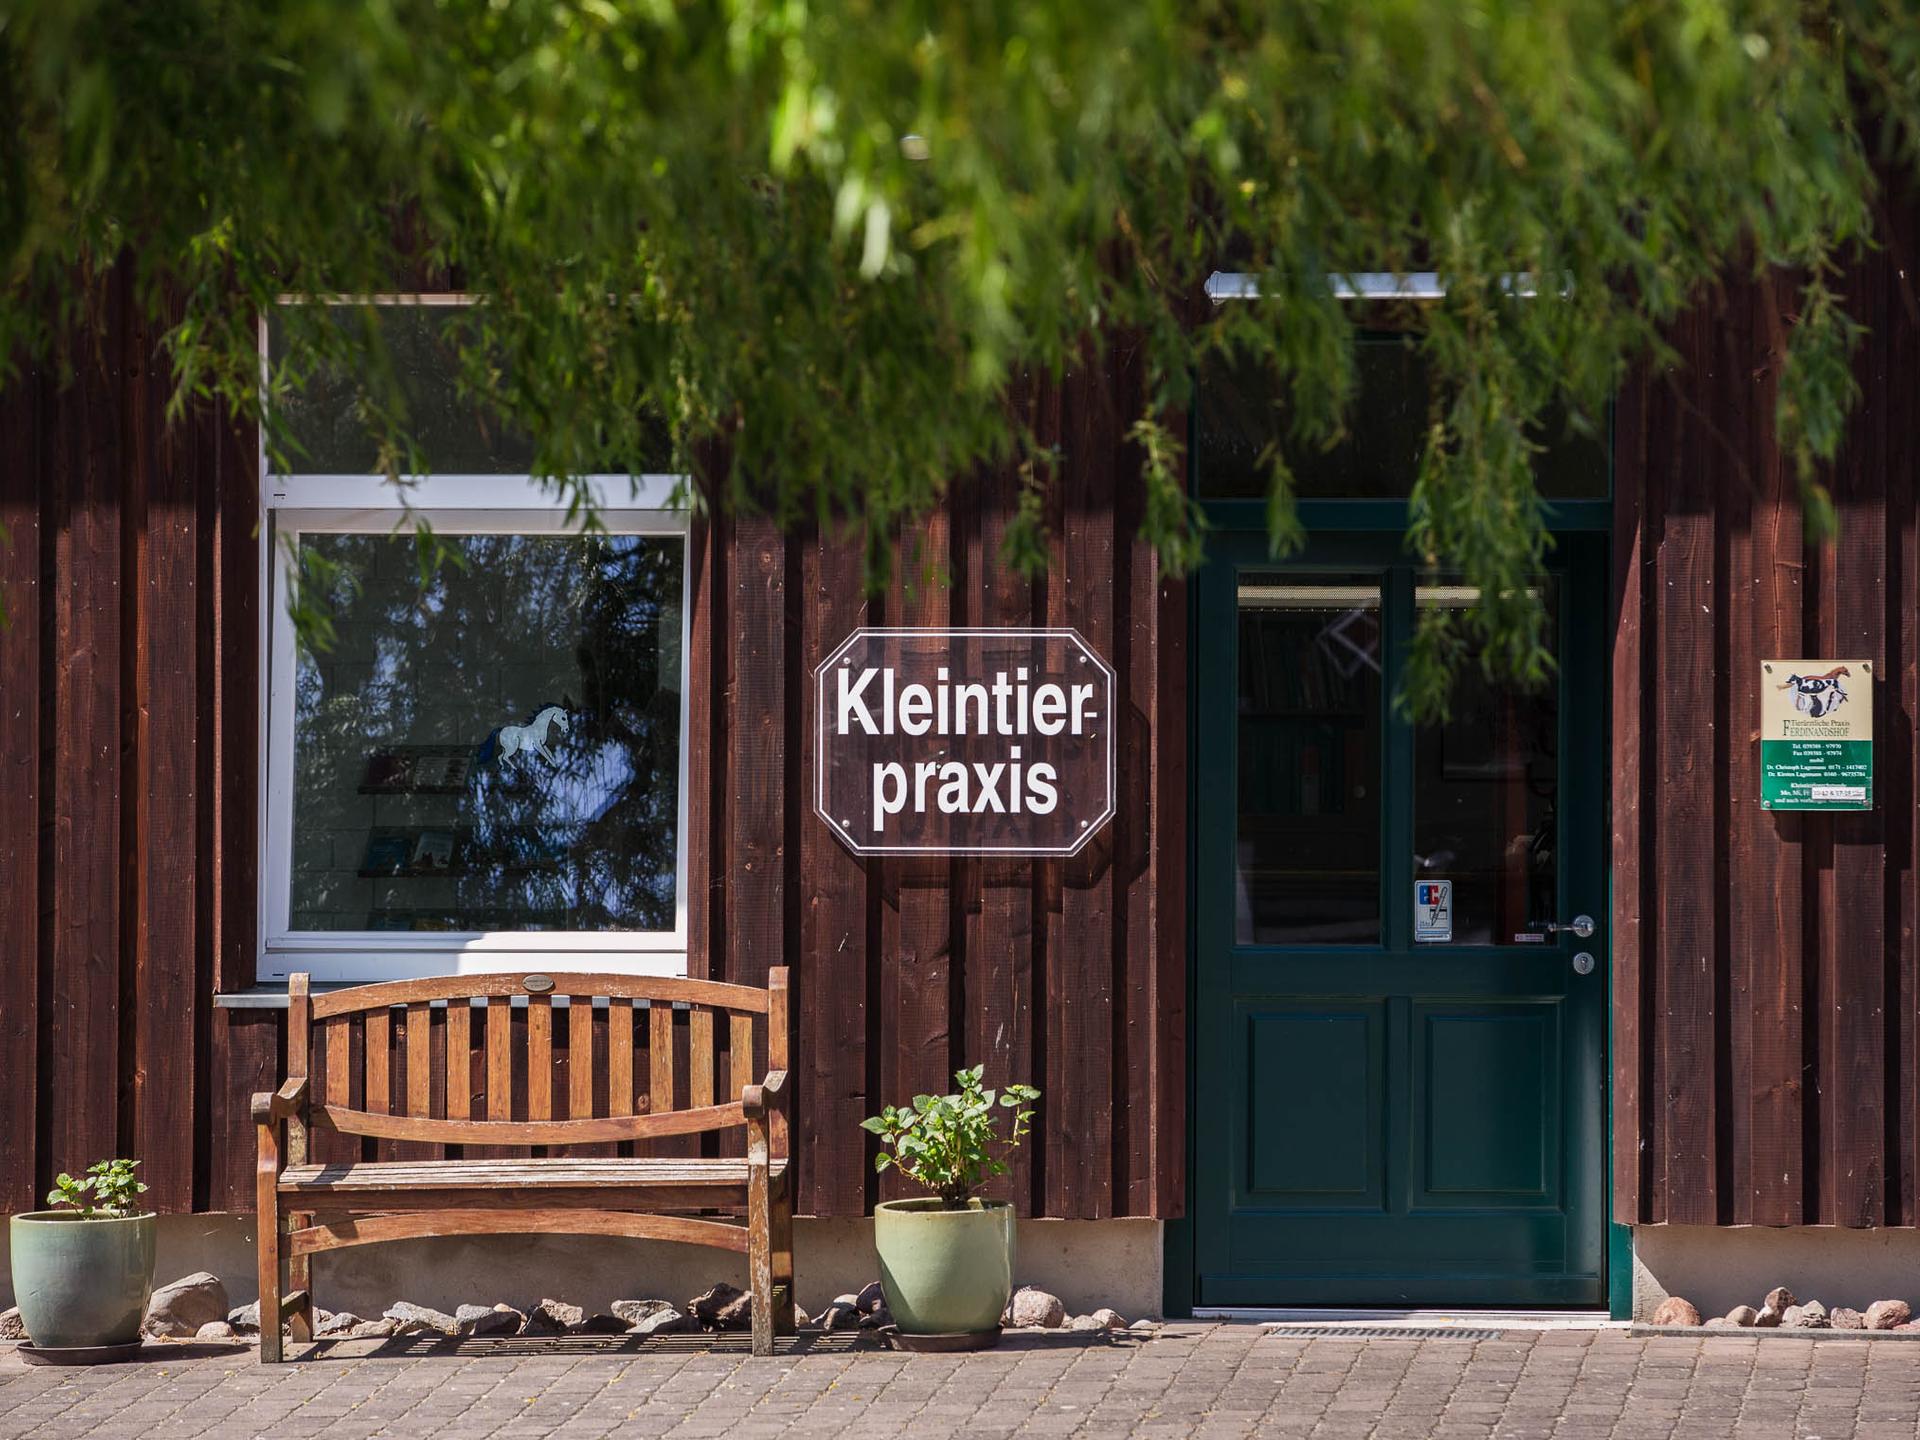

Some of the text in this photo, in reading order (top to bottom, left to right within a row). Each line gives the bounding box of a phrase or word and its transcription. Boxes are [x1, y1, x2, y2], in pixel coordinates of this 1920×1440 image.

[837, 667, 1097, 736] Kleintier-
[1830, 719, 1850, 727] Praxis
[873, 745, 1058, 832] praxis
